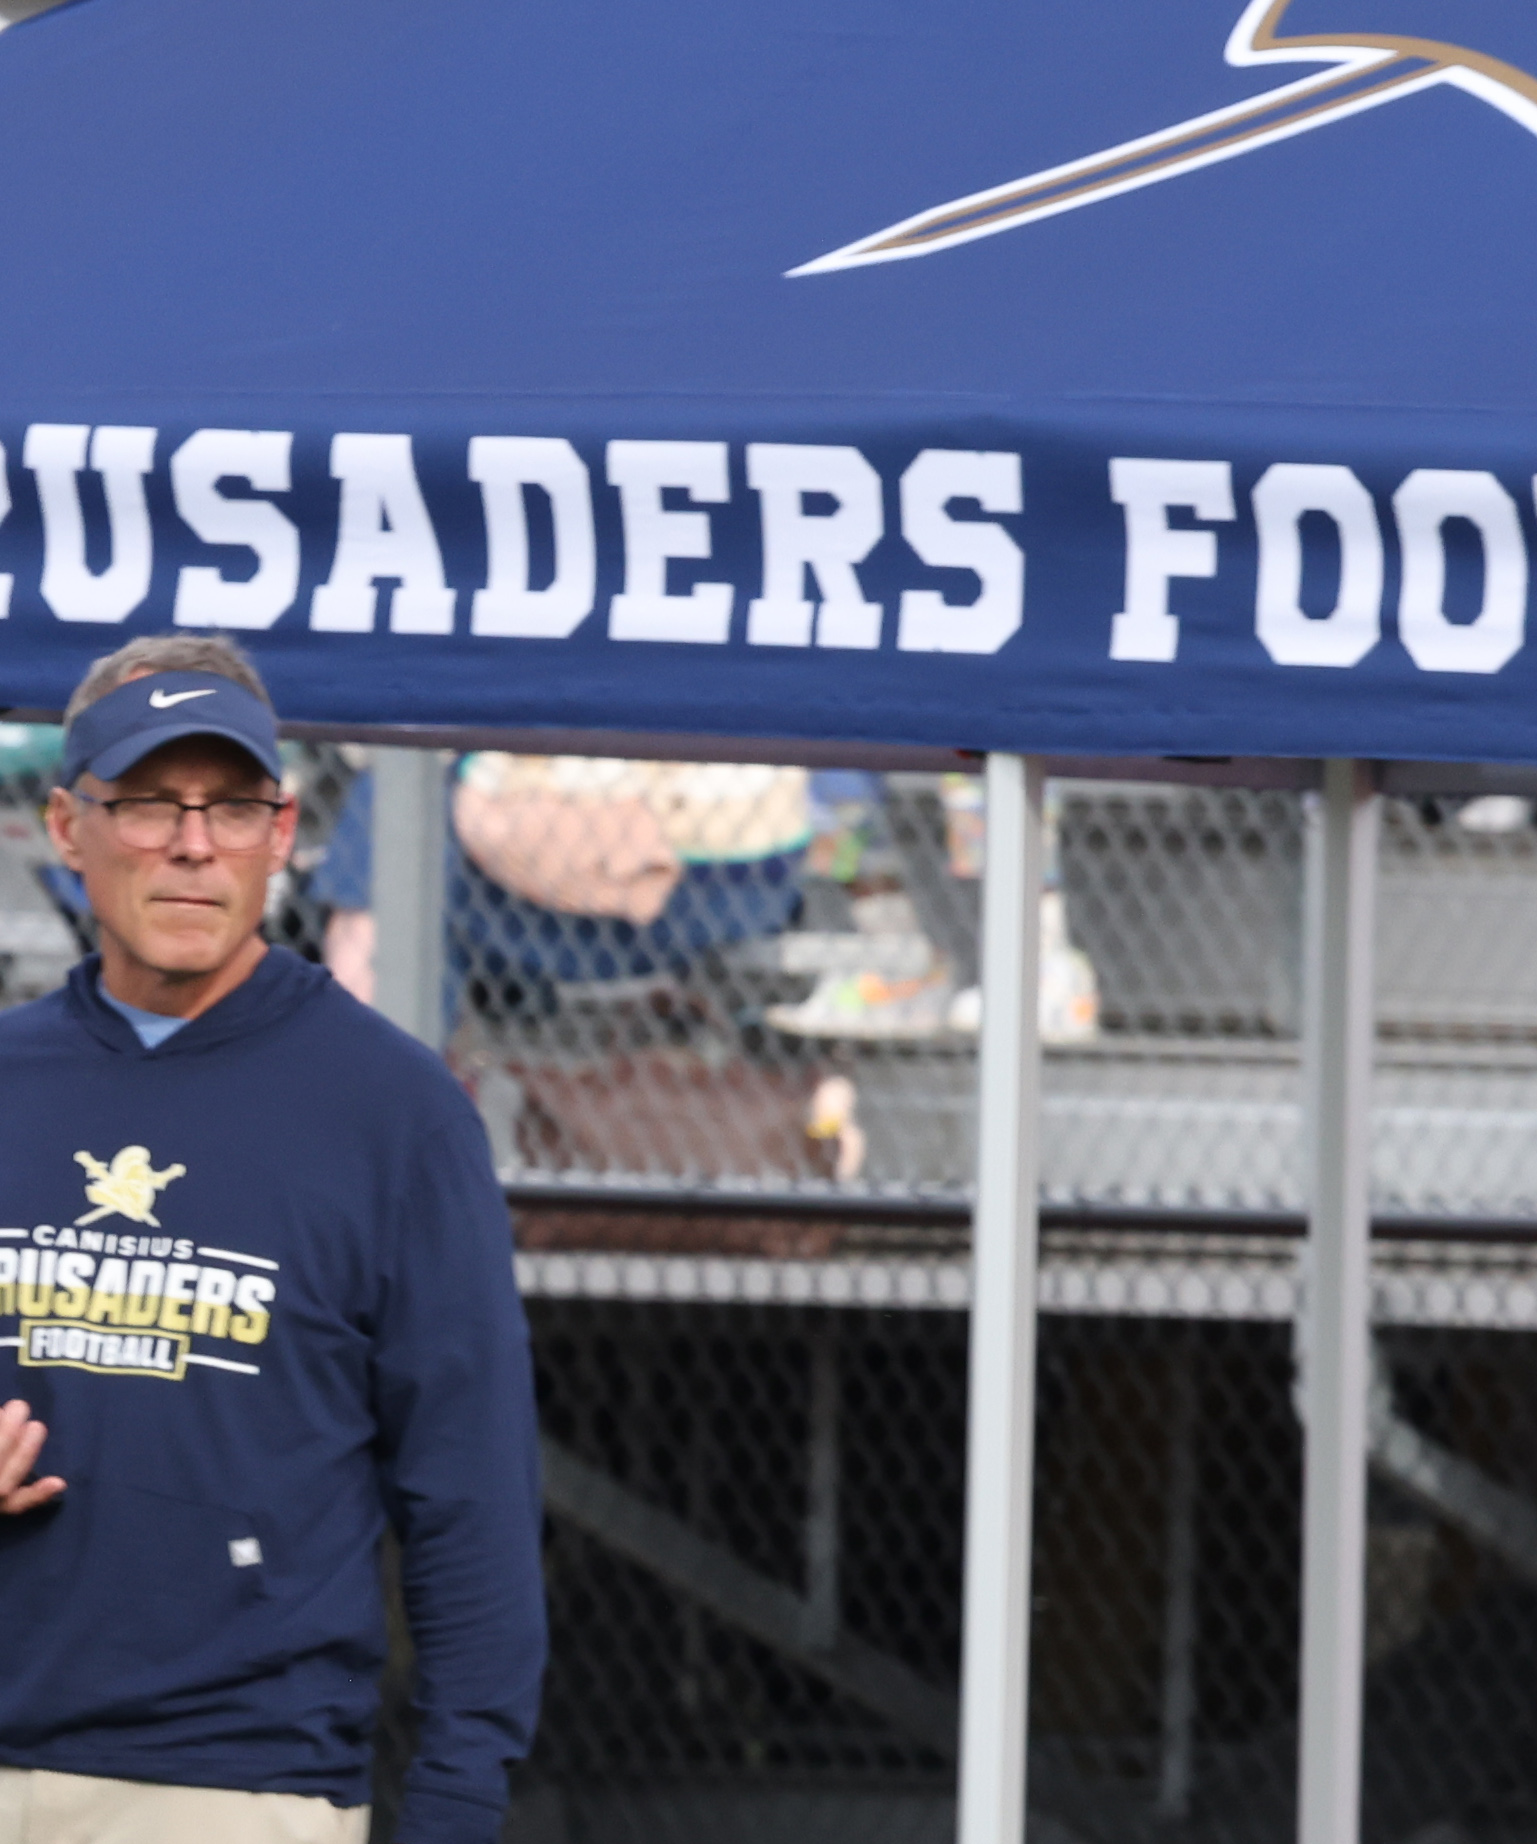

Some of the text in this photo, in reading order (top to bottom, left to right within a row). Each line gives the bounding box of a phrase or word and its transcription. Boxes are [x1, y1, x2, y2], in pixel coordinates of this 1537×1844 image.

[0, 423, 1025, 654] USADERS
[32, 1224, 194, 1259] CANISIUS
[30, 1327, 175, 1371] FOOTBALL
